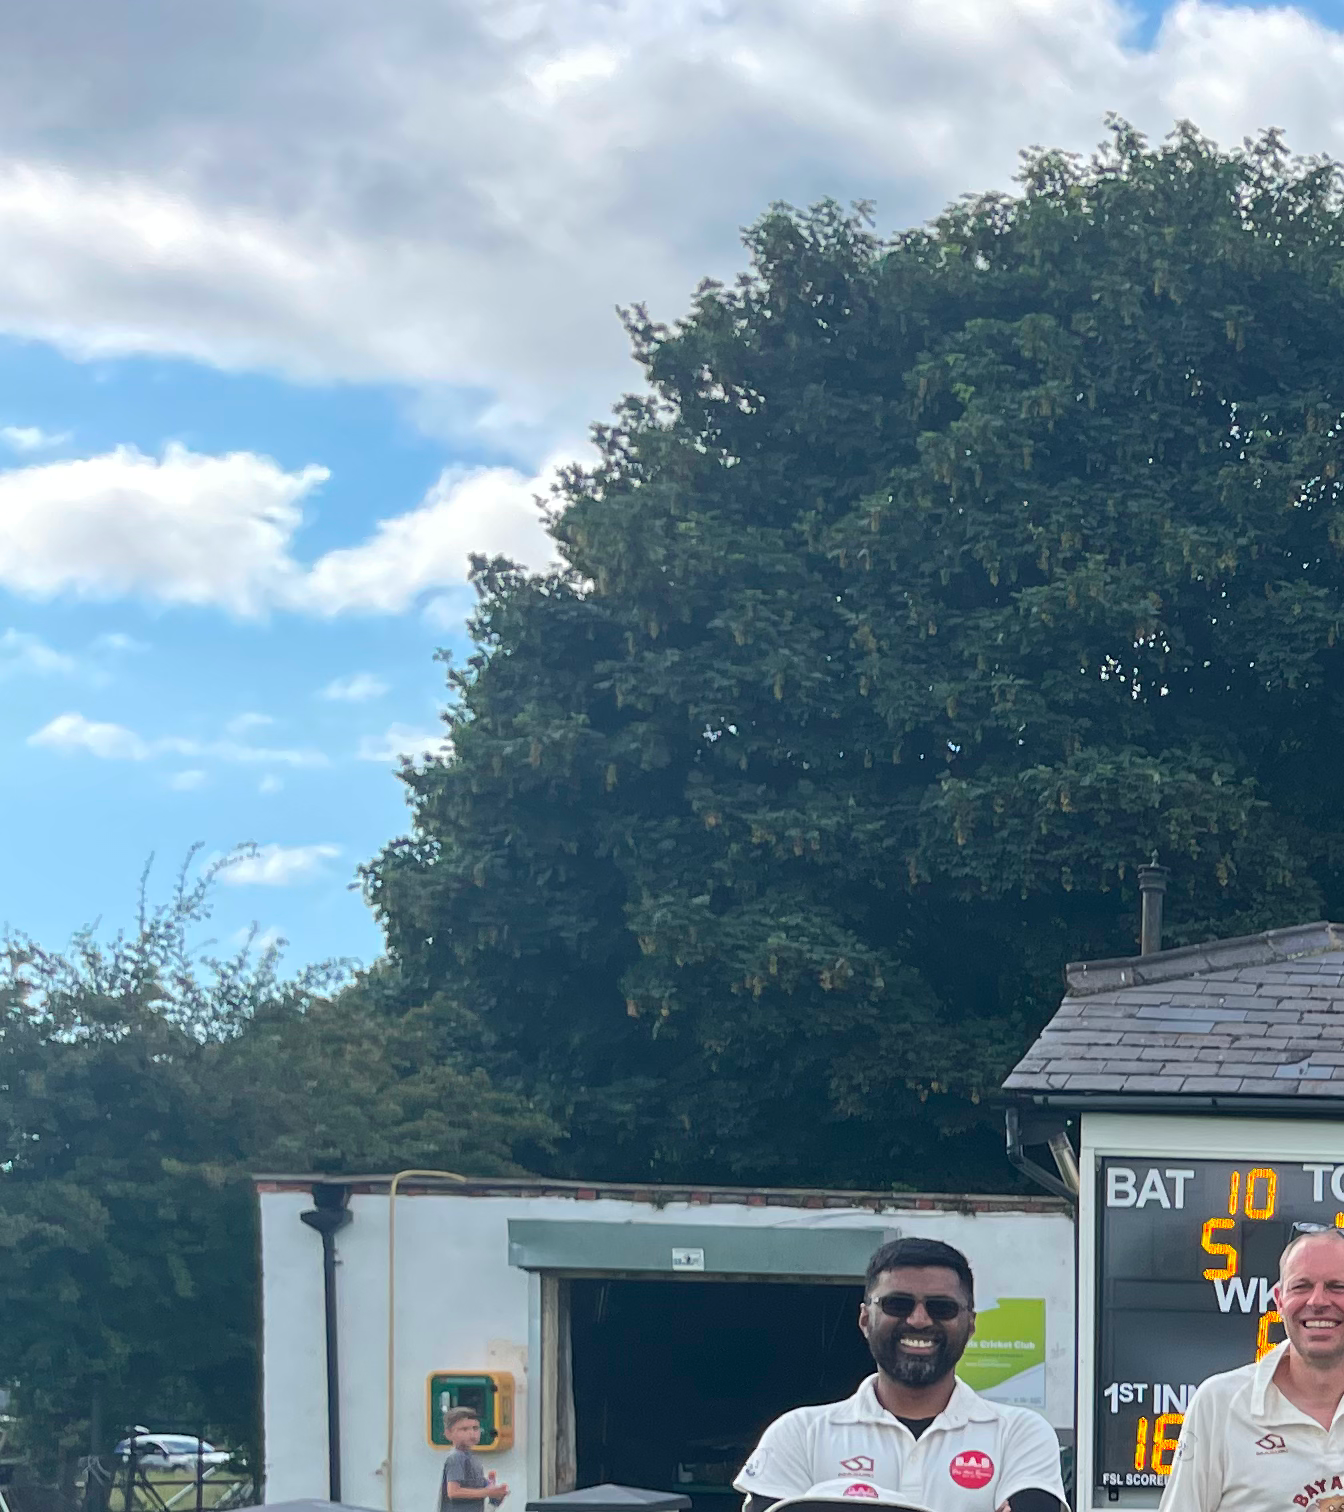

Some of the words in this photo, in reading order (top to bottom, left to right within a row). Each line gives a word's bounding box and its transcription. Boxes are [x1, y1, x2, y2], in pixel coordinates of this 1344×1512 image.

[1107, 1167, 1195, 1210] BAT
[1228, 1167, 1278, 1220] 10
[1201, 1218, 1238, 1281] 5
[1213, 1276, 1281, 1314] WK
[1104, 1382, 1148, 1414] 1ST
[1102, 1472, 1123, 1486] FSL
[1293, 1478, 1327, 1508] BAY
